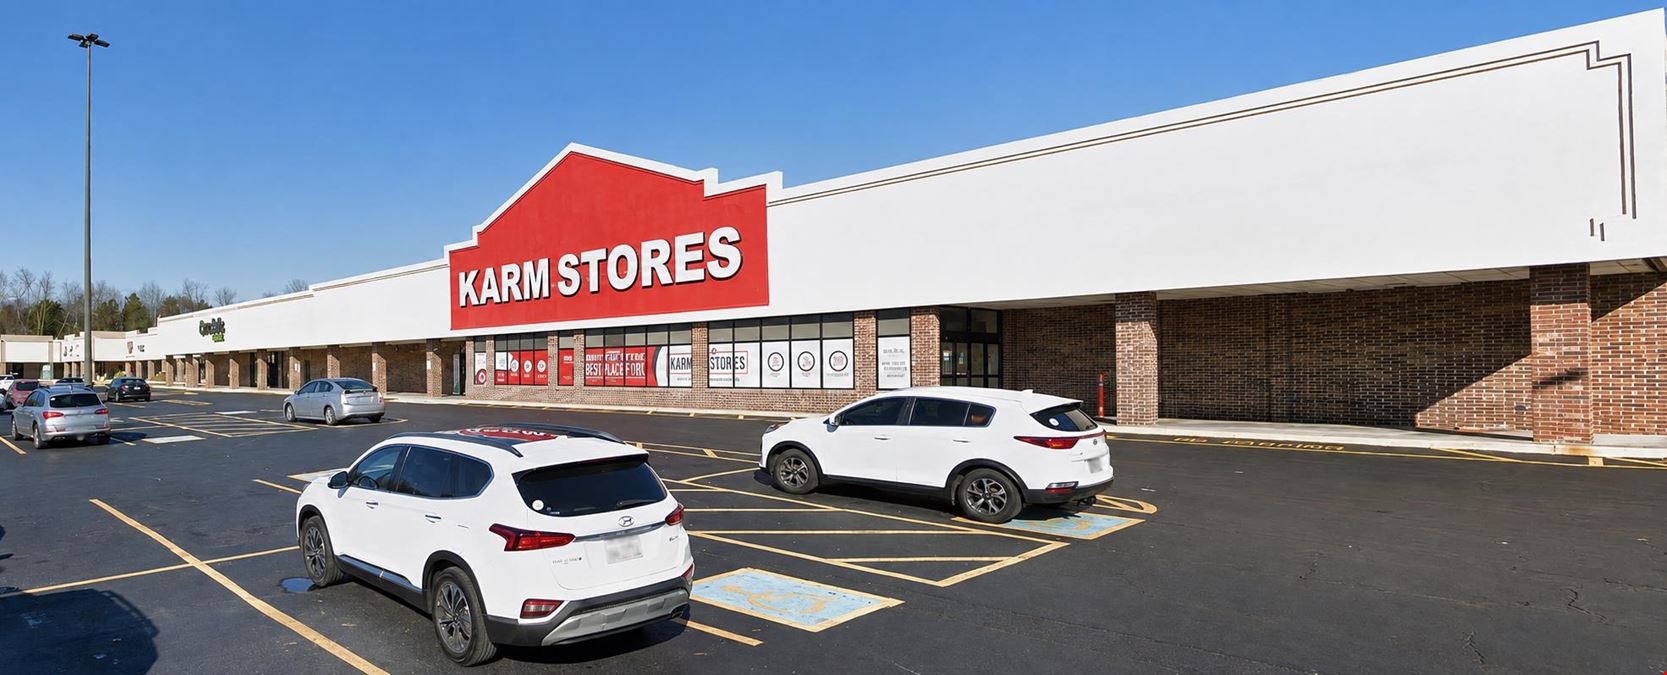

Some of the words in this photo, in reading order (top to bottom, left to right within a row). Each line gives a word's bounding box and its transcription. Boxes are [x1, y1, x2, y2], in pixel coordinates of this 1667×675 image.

[459, 258, 550, 307] KARM
[557, 226, 743, 296] STORES
[710, 355, 746, 370] STORES
